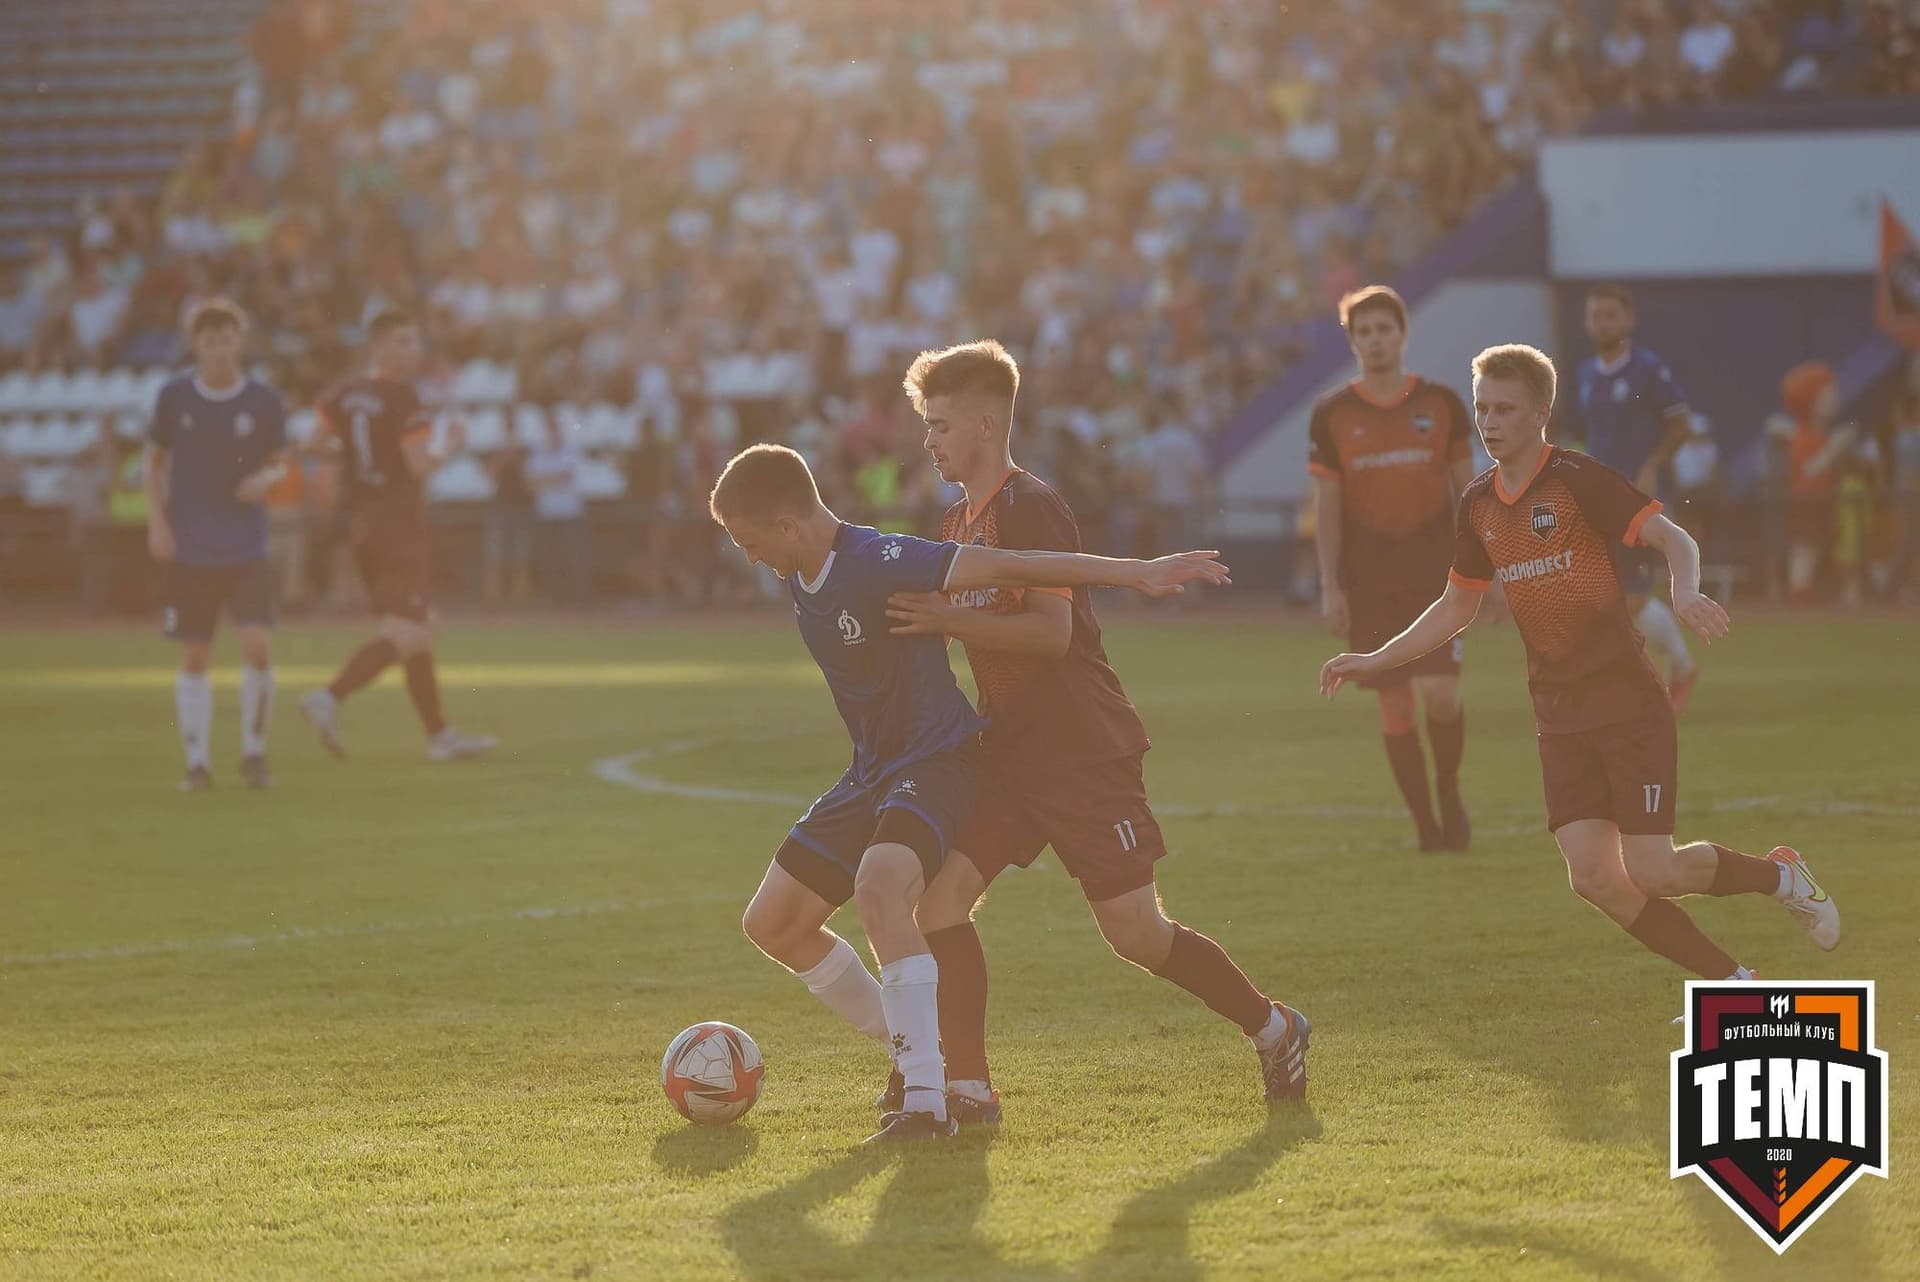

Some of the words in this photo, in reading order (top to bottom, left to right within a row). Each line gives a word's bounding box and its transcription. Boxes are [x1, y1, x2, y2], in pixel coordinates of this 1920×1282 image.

[1533, 514, 1555, 529] ТЕМП
[1643, 784, 1661, 813] 17
[1113, 820, 1137, 851] 11
